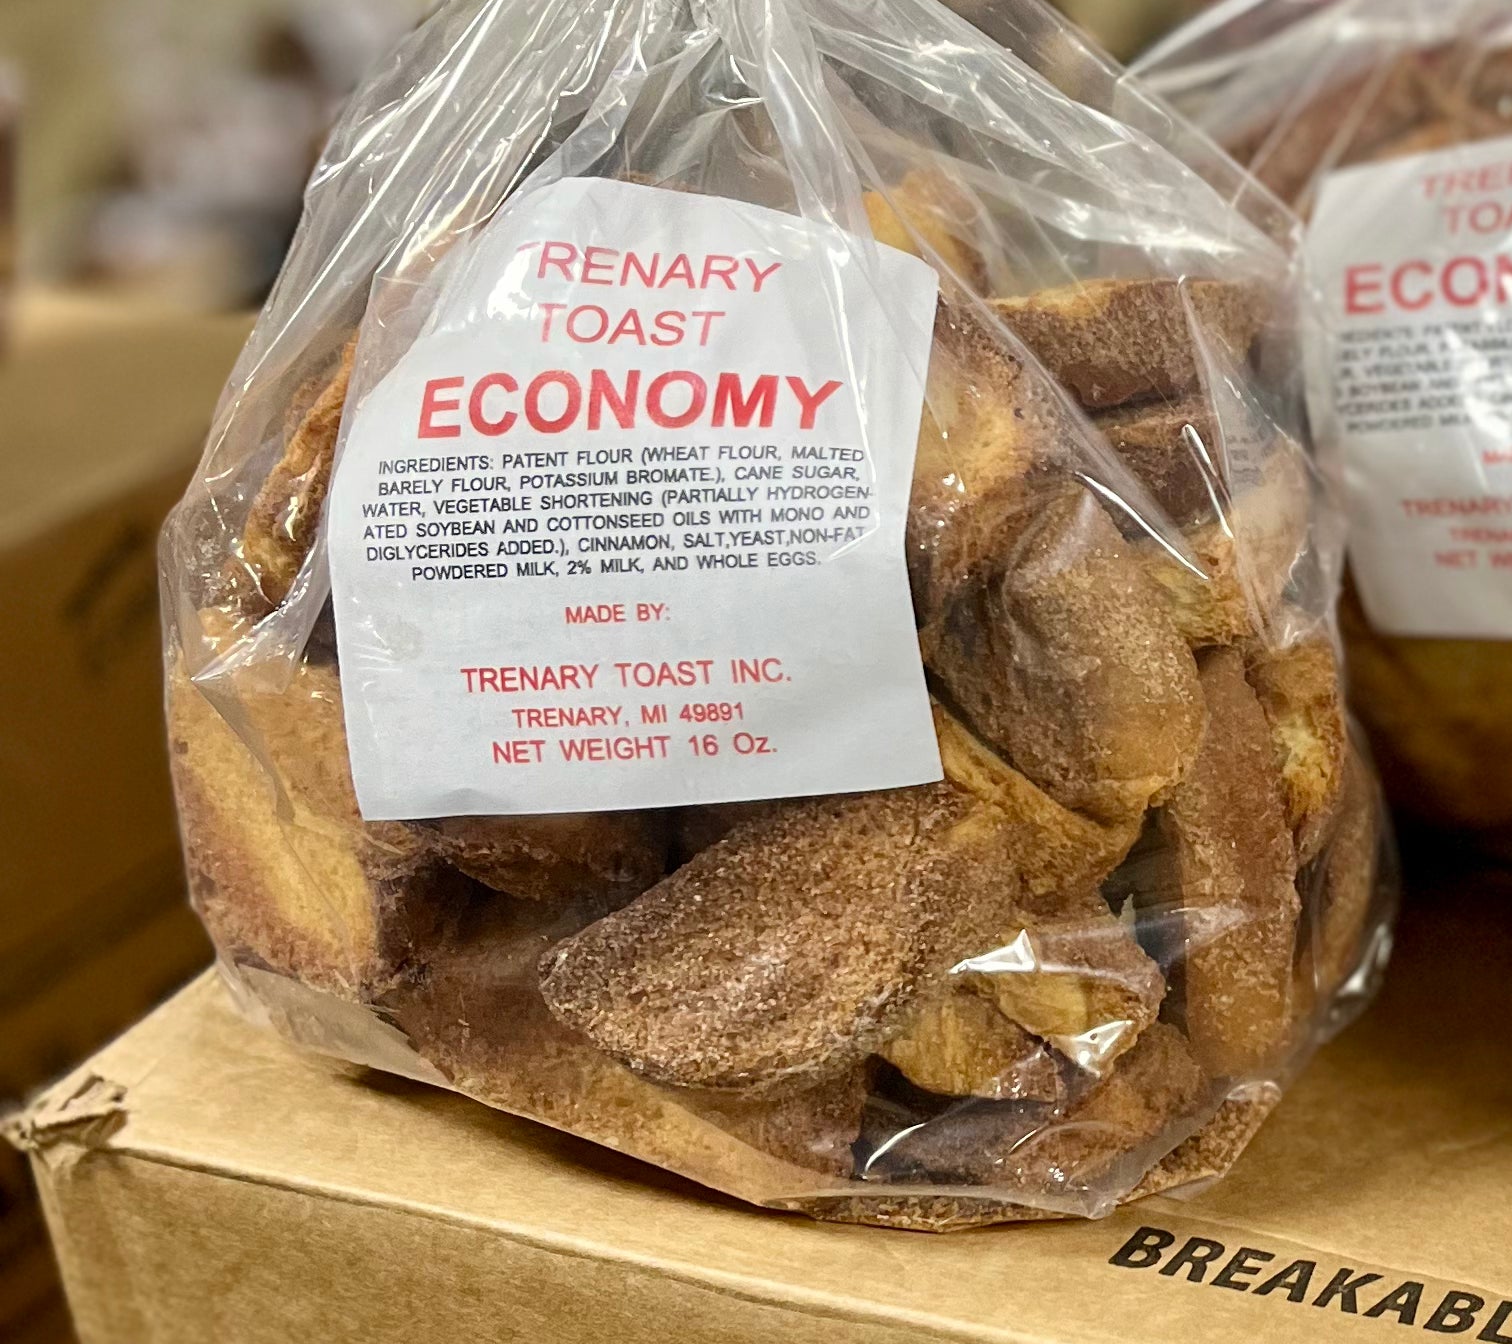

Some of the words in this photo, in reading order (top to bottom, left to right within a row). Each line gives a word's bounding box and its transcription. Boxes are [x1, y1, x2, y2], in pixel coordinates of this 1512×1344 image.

[538, 303, 726, 347] TOAST
[418, 369, 843, 439] ECONOMY
[378, 455, 494, 475] INGREDIENTS:
[502, 452, 568, 469] PATENT
[577, 448, 633, 465] FLOUR
[641, 445, 710, 465] (WHEAT
[718, 445, 782, 461] FLOUR,
[791, 446, 864, 462] MALTED
[378, 479, 443, 496] BARELY
[451, 476, 511, 492] FLOUR,
[520, 470, 618, 490] POTASSIUM
[734, 465, 783, 481] CANE
[792, 465, 860, 482] SUGAR,
[362, 501, 426, 518] WATER,
[433, 496, 532, 515] VEGETABLE
[540, 491, 652, 510] SHORTENING
[661, 486, 760, 508] (PARTIALLY
[767, 485, 873, 501] HYDROGEN-
[363, 524, 408, 540] ATED
[416, 519, 495, 538] SOYBEAN
[503, 518, 538, 534] AND
[547, 513, 664, 532] COTTONSEED
[673, 510, 711, 527] OILS
[719, 509, 762, 525] WITH
[771, 506, 824, 523] MONO
[833, 505, 870, 520] AND
[367, 542, 489, 561] DIGLYCERIDES
[499, 538, 569, 557] ADDED.),
[578, 534, 675, 553] CINNAMON,
[412, 562, 508, 581] POWDERED
[517, 560, 560, 577] MILK,
[567, 559, 592, 576] 2%
[600, 557, 645, 574] MILK,
[653, 555, 689, 571] AND
[697, 553, 759, 569] WHOLE
[767, 551, 821, 567] EGGS.
[565, 604, 625, 624] MADE
[637, 603, 671, 622] BY:
[460, 664, 600, 693] TRENARY
[614, 660, 714, 687] TOAST
[731, 657, 793, 684] INC.
[512, 706, 630, 729] TRENARY,
[641, 704, 668, 724] MI
[679, 702, 744, 723] 49891
[492, 740, 546, 765] NET
[559, 735, 671, 762] WEIGHT
[688, 734, 719, 757] 16
